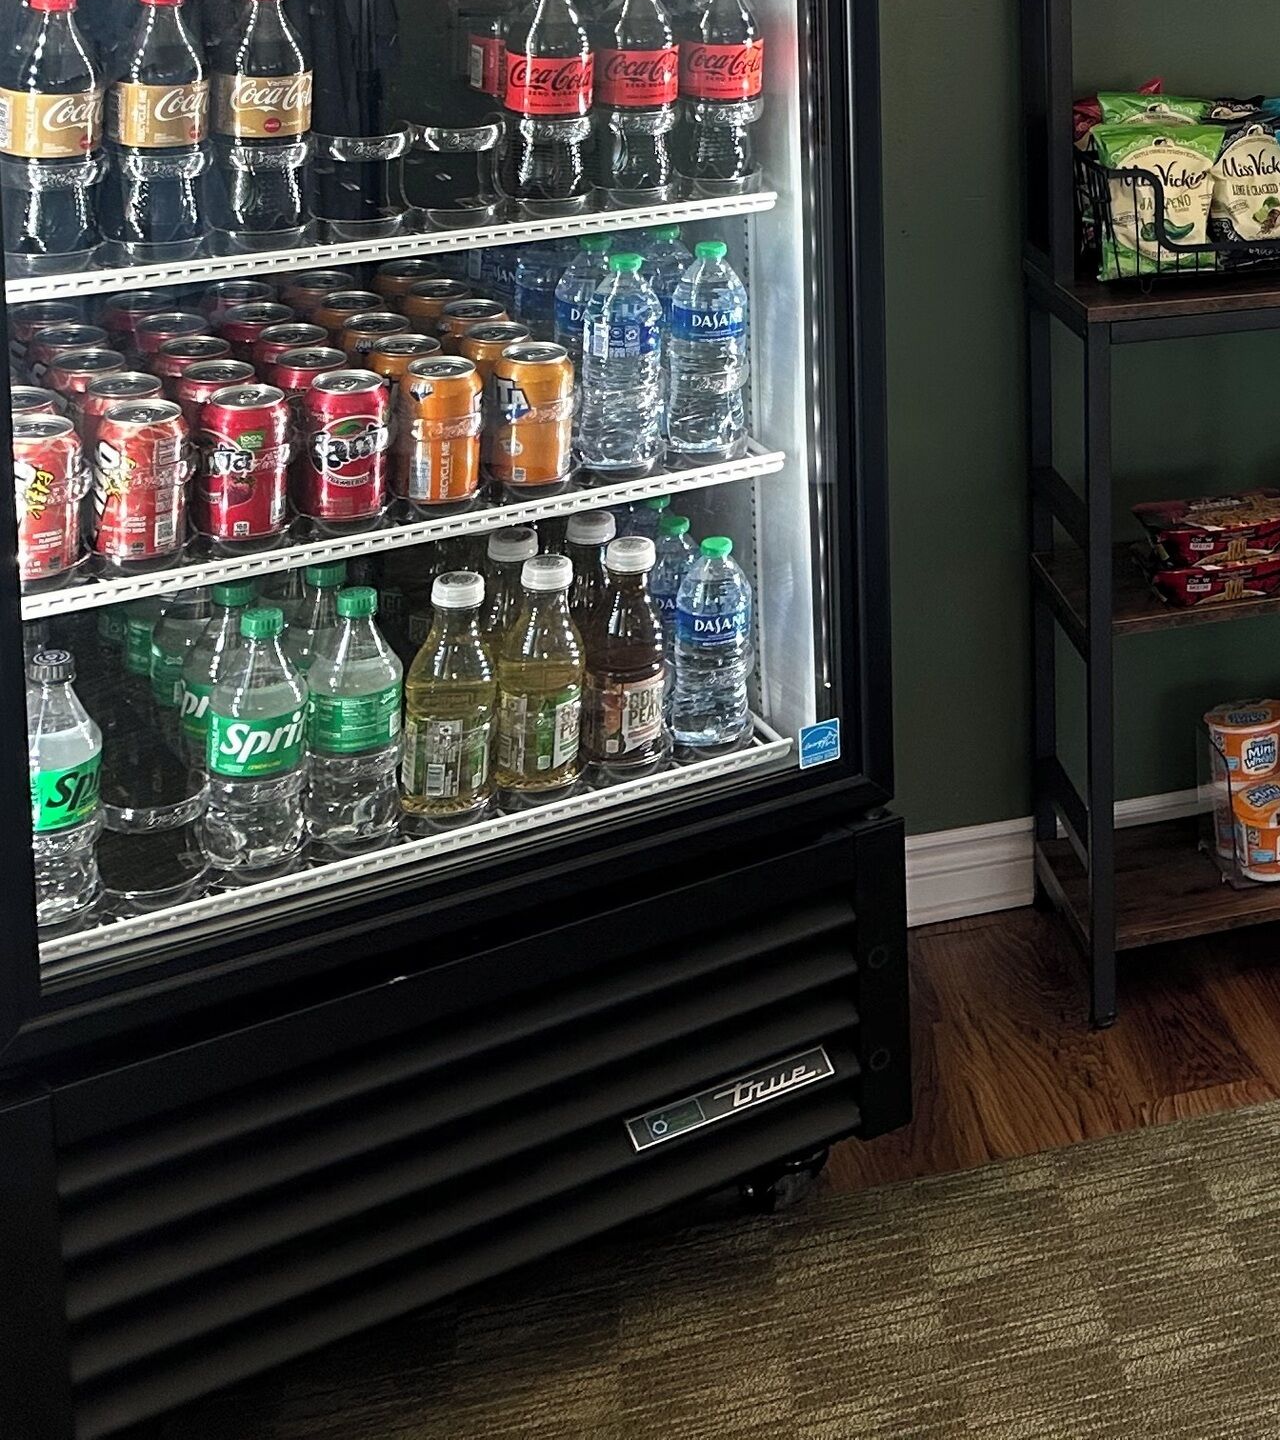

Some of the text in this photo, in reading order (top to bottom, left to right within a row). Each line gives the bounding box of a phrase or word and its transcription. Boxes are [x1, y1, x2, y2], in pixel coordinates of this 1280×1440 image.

[1222, 158, 1253, 178] Miss
[439, 441, 450, 499] RECYCLE ME
[219, 711, 307, 765] Spri
[1247, 742, 1275, 759] Mini
[1248, 785, 1280, 801] Mini
[713, 1065, 816, 1107] true
